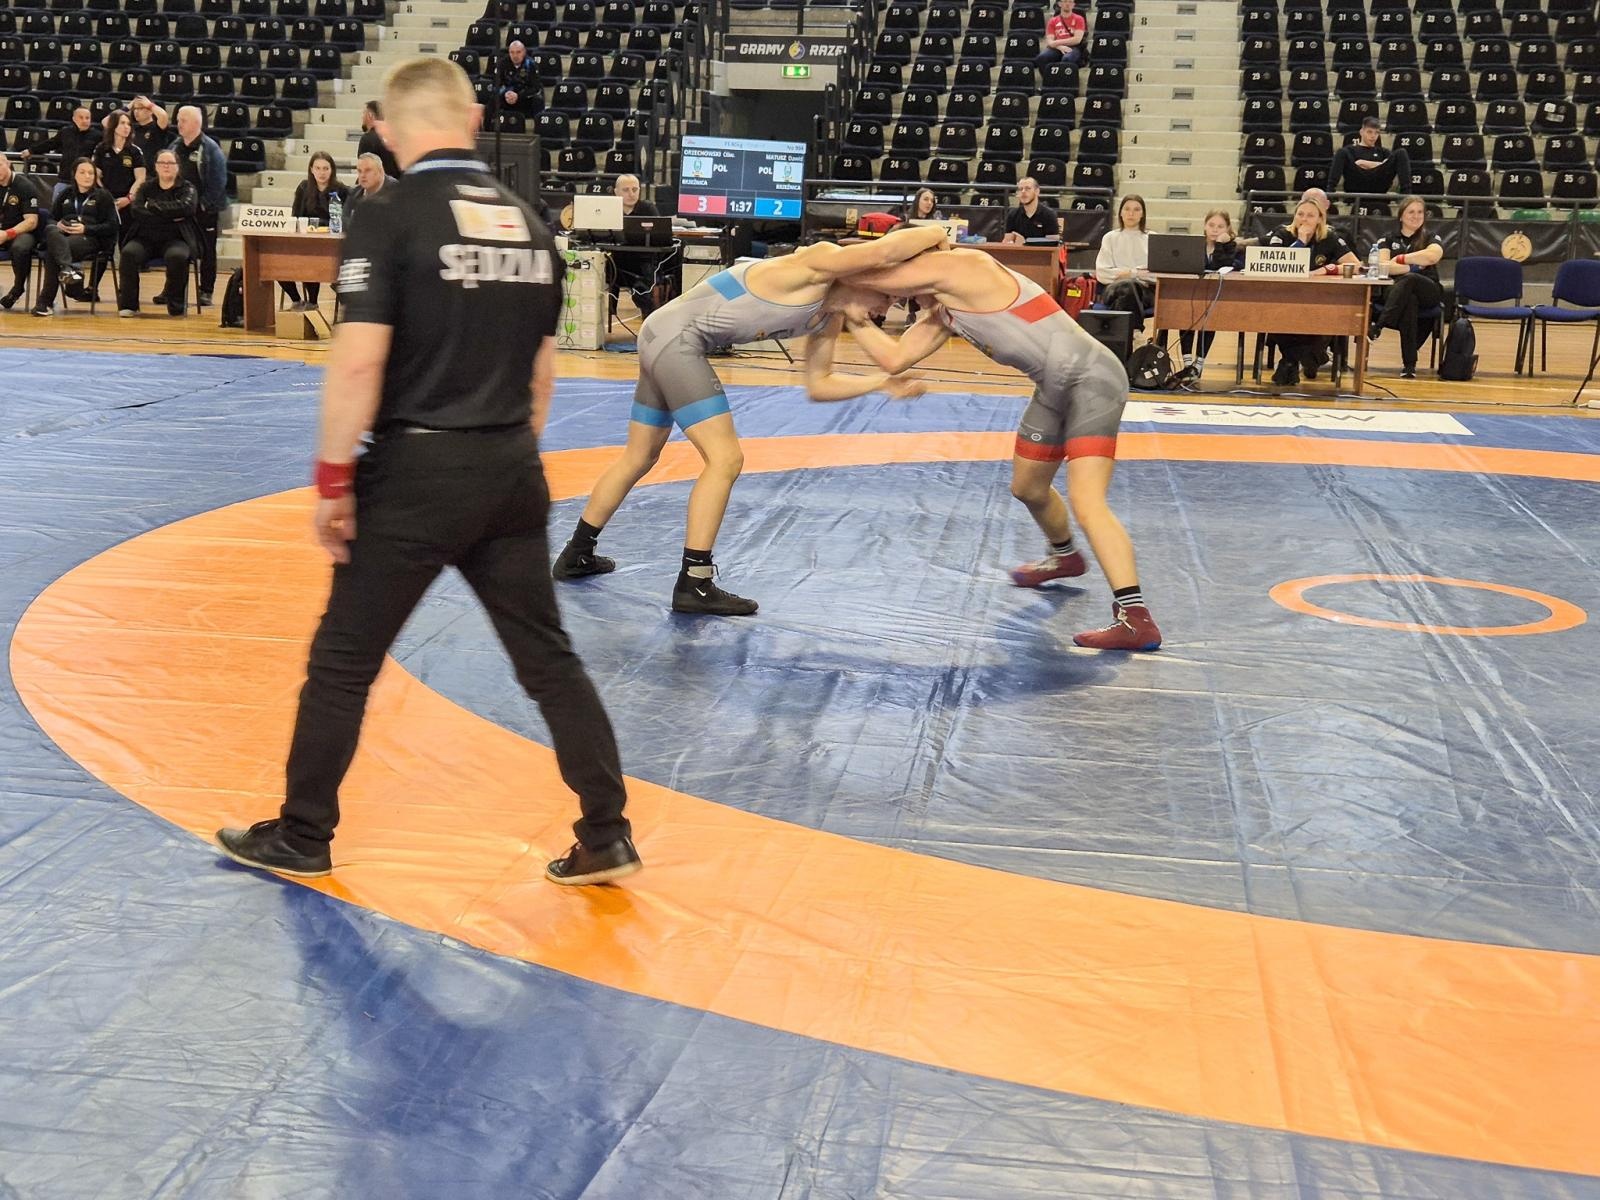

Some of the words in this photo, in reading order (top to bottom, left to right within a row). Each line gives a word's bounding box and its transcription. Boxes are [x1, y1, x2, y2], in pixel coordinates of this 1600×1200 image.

[740, 43, 785, 55] GRAMY
[1136, 74, 1142, 82] 6
[350, 85, 356, 93] 5
[1134, 104, 1140, 113] 5
[320, 114, 325, 122] 4
[1131, 136, 1137, 144] 4
[303, 145, 309, 153] 3
[713, 164, 728, 172] POL
[1129, 170, 1136, 178] 3
[268, 177, 274, 185] 2
[698, 196, 707, 212] 3
[730, 200, 752, 212] 1:37
[774, 200, 783, 215] 2
[247, 208, 284, 217] SĘDZIA
[1260, 251, 1286, 260] MATA
[1290, 252, 1296, 260] II
[1250, 262, 1305, 273] KIEROWNIK
